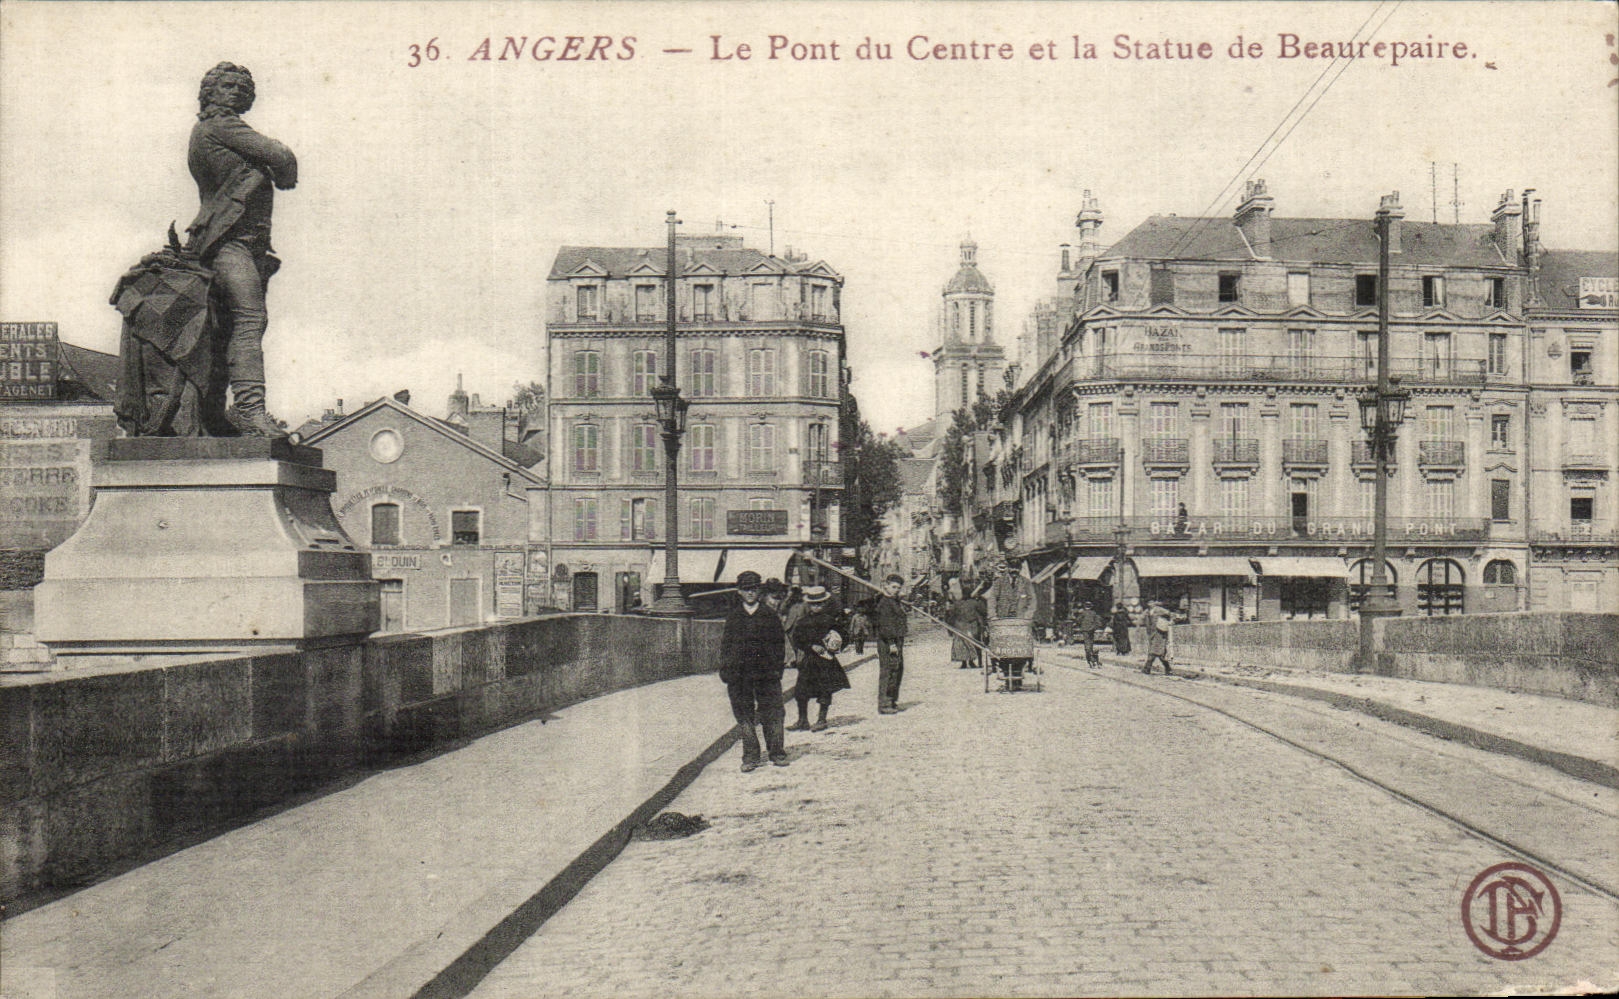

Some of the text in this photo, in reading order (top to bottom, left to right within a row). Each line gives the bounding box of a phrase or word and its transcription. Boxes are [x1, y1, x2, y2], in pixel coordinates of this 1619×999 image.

[1150, 521, 1457, 536] BAZAR DU GRAND PONT
